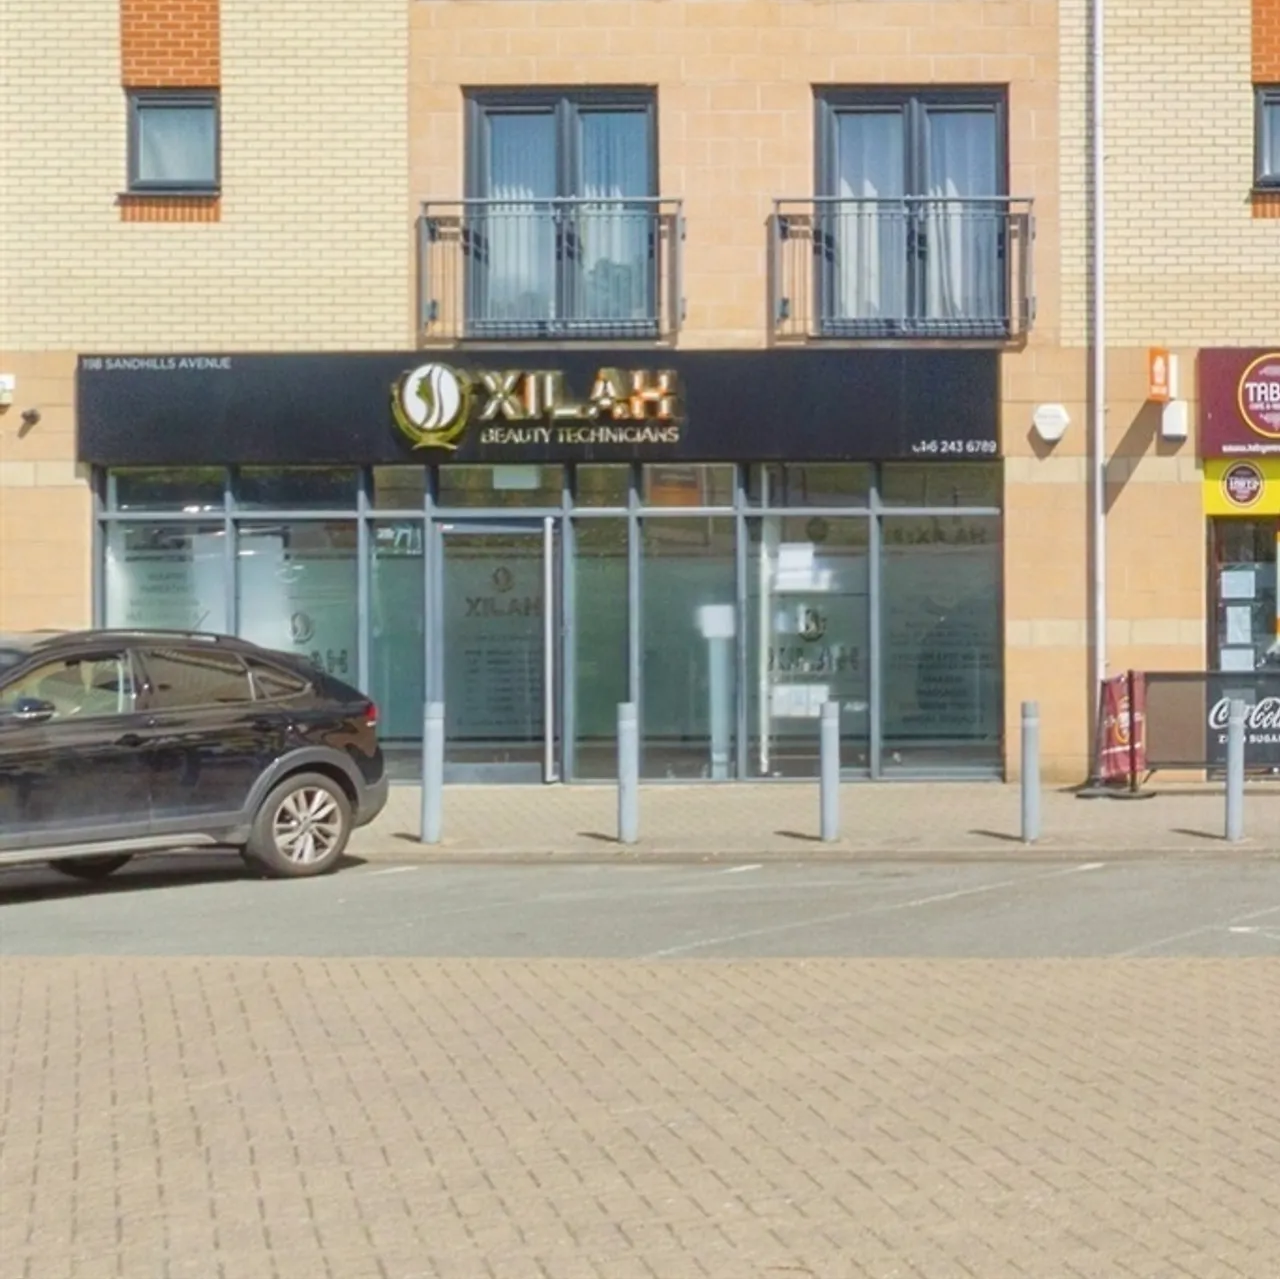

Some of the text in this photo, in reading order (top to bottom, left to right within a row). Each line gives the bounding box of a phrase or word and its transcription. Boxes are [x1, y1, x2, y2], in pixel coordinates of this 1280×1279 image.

[105, 357, 176, 370] SANDHILLS
[178, 357, 231, 370] AVENUE
[480, 368, 678, 419] XILAH
[481, 426, 680, 443] BEAUTY TECHNICIANS
[940, 440, 963, 453] 243
[966, 439, 997, 453] 6789
